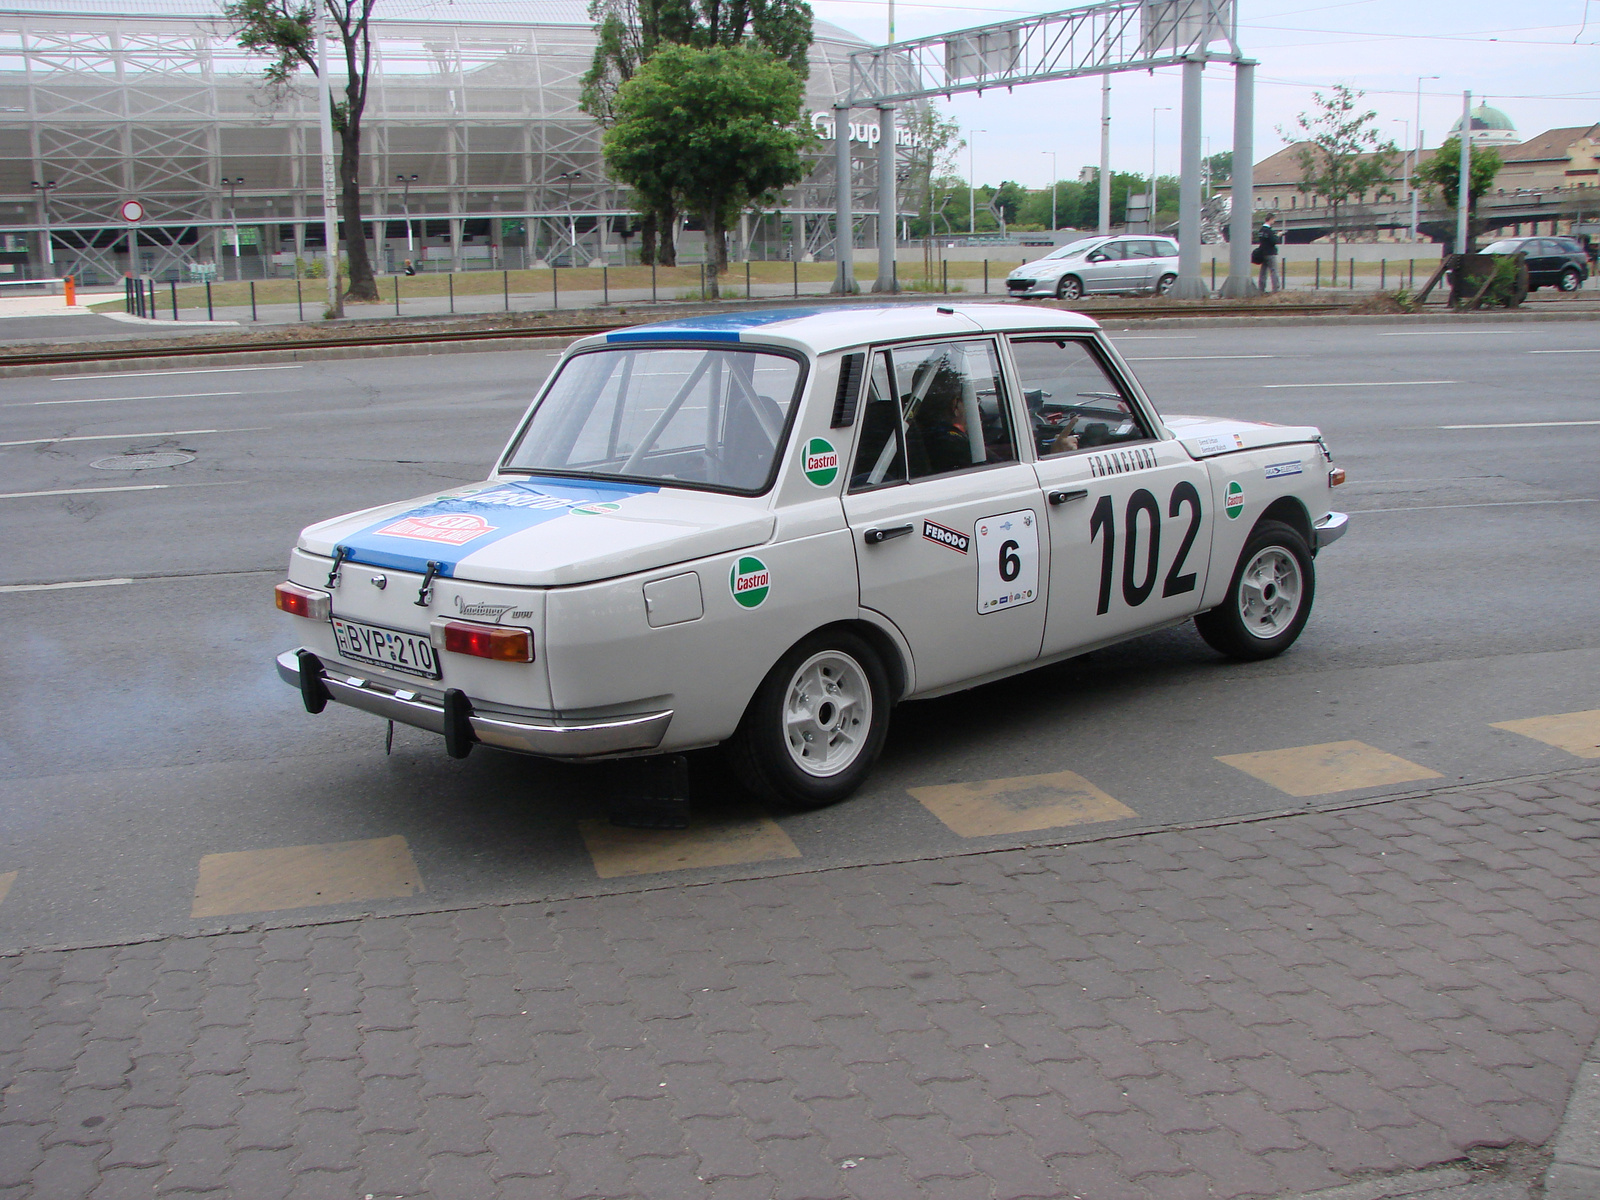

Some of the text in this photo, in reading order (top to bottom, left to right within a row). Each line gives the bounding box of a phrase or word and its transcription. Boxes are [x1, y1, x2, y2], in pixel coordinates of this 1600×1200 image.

[808, 454, 837, 470] Castrol
[1088, 447, 1158, 478] FRANCFORT
[1227, 494, 1244, 506] Castrol
[925, 524, 966, 550] FERODO
[1090, 480, 1202, 615] 102
[999, 539, 1020, 582] 6
[737, 572, 769, 591] Castrol
[339, 635, 348, 649] H
